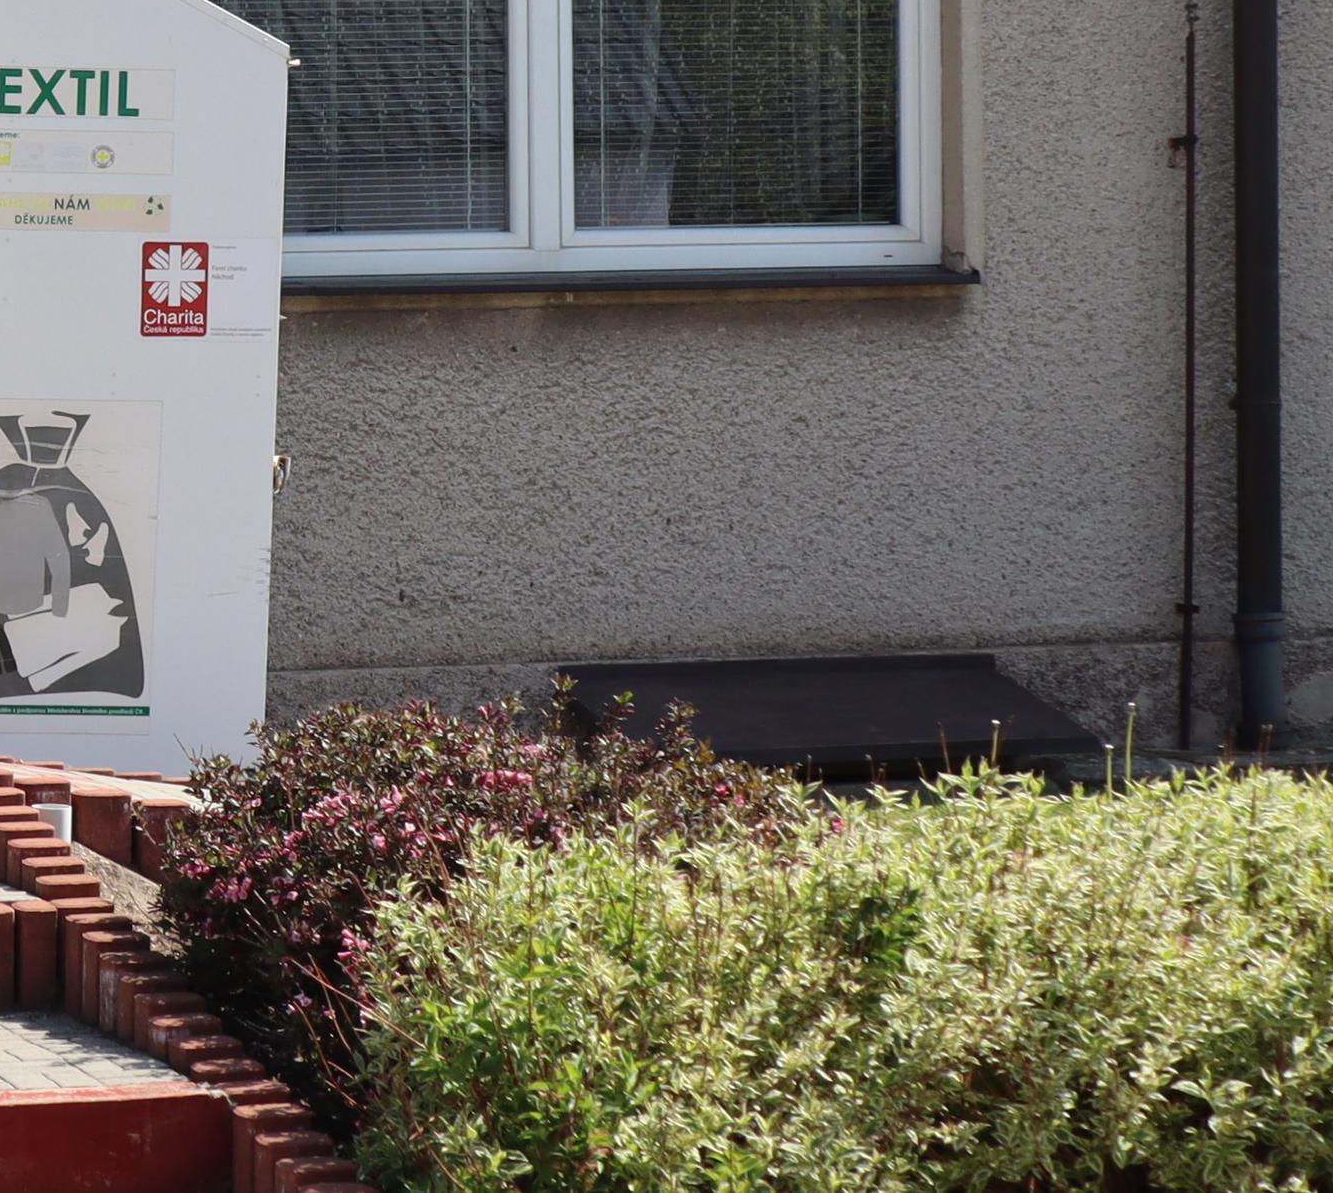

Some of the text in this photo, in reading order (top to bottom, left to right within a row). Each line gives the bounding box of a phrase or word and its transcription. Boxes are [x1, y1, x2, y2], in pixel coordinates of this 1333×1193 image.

[54, 194, 90, 211] NÁM
[14, 212, 74, 225] DĚKUJEME
[143, 308, 205, 325] Charita
[143, 325, 168, 333] Česká
[169, 325, 204, 334] republika
